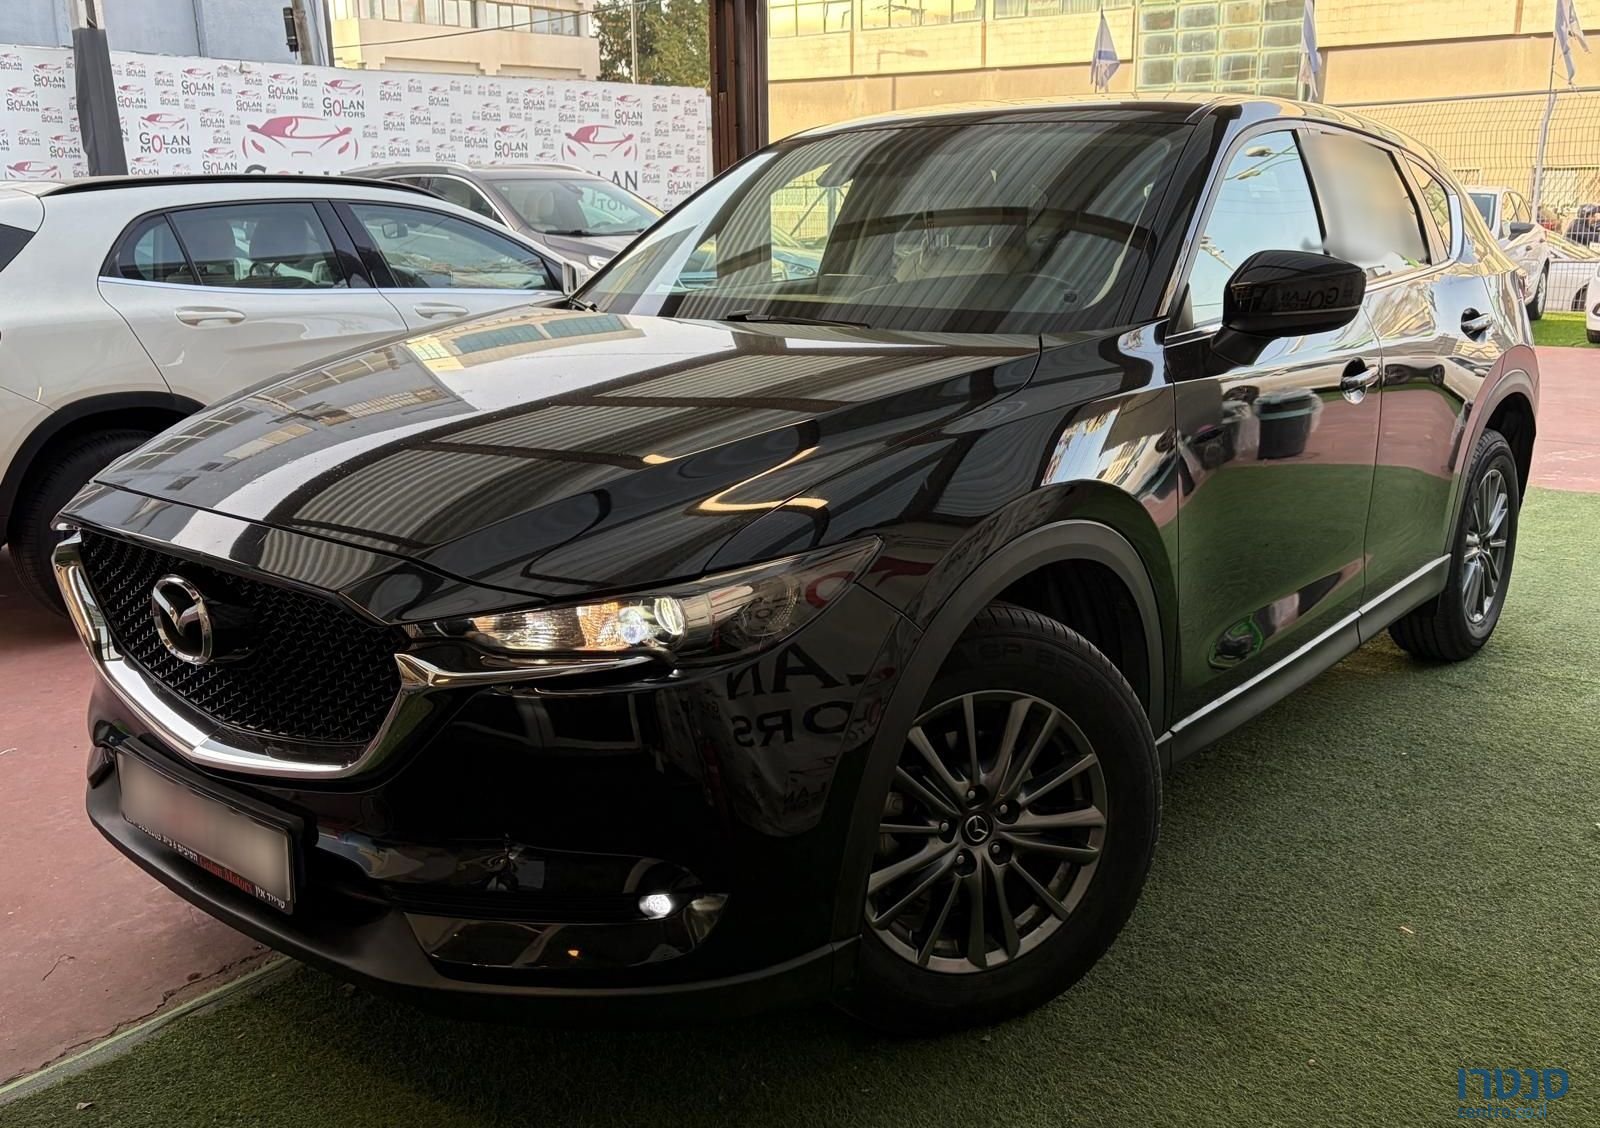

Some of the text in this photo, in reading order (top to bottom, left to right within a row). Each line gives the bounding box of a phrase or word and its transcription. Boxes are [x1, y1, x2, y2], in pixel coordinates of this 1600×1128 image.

[33, 74, 65, 83] GOLAN
[181, 80, 214, 90] GOLAN
[268, 85, 298, 95] GOLAN
[6, 98, 38, 107] GOLAN
[118, 96, 146, 104] GOLAN
[323, 97, 364, 110] GOLAN
[323, 110, 365, 118] MOTORS
[615, 110, 642, 119] GOLAN
[140, 132, 190, 145] GOLAN
[141, 146, 192, 154] MOTORS
[495, 140, 528, 151] GOLAN
[203, 160, 237, 170] GOLAN
[131, 167, 159, 175] GOLAN
[667, 180, 692, 189] GOLAN
